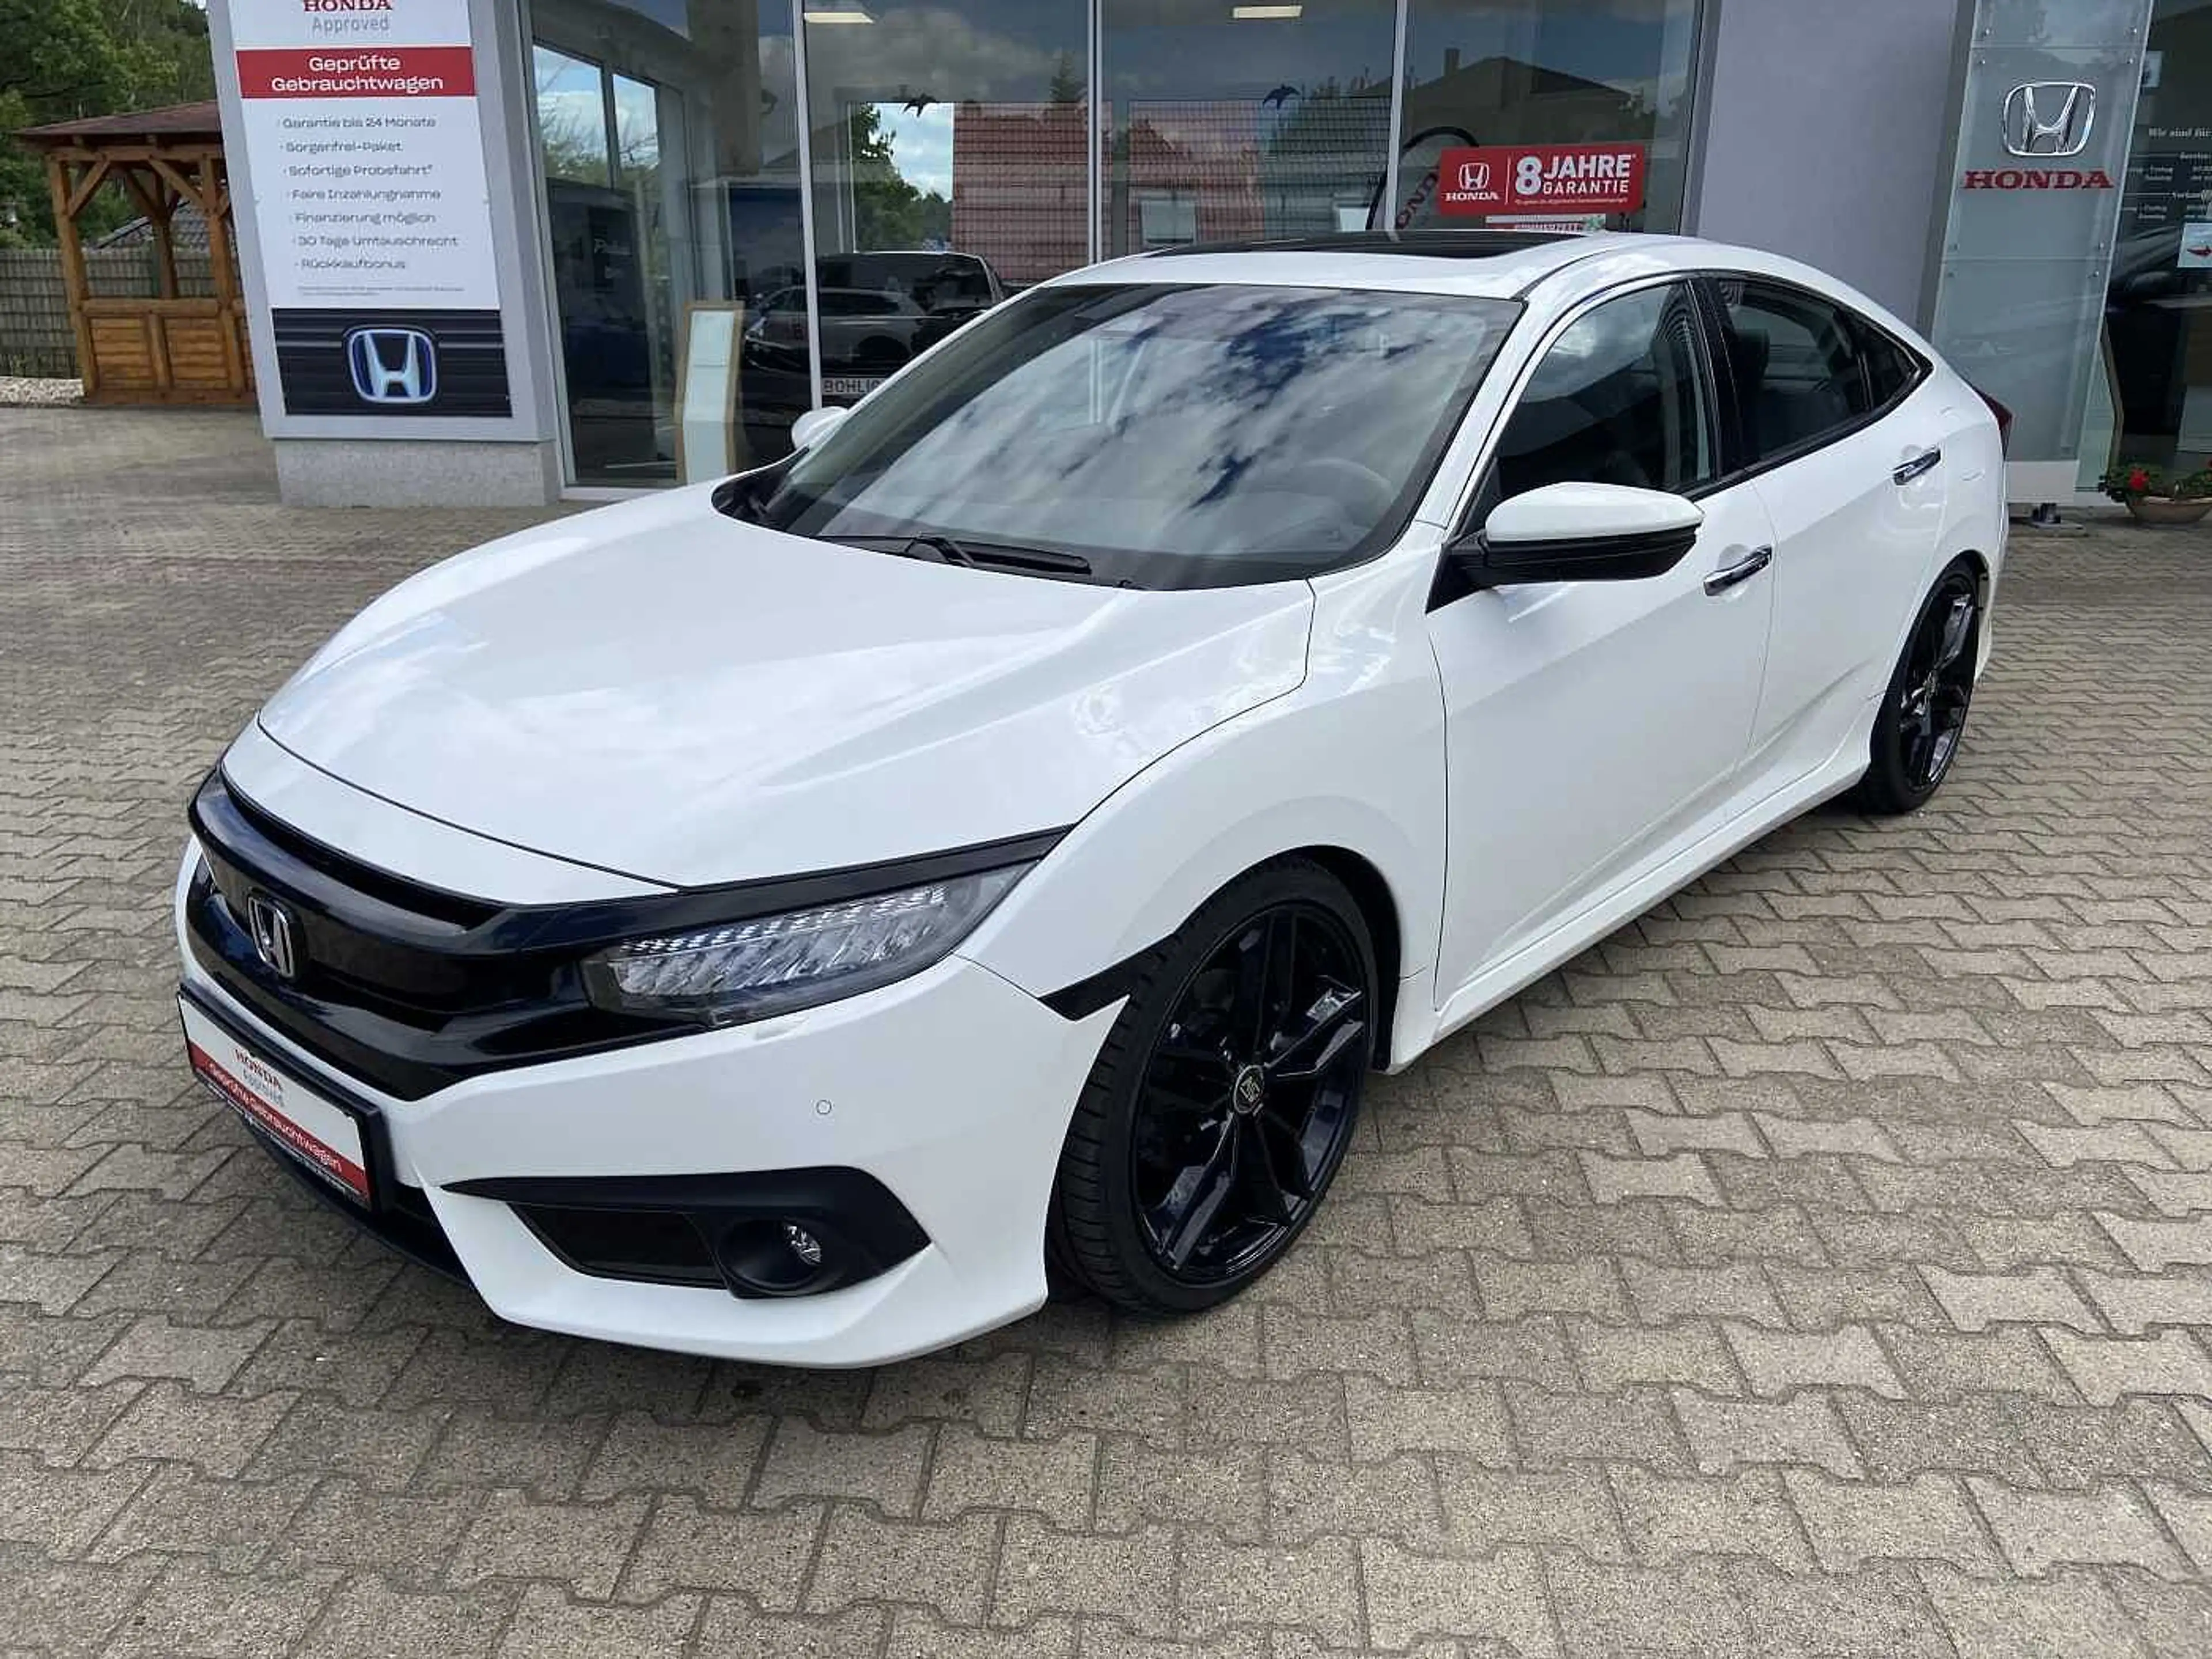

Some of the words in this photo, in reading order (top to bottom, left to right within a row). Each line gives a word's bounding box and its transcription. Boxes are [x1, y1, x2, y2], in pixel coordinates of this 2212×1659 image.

[304, 0, 393, 12] HONDA
[312, 14, 389, 33] Approved
[308, 54, 401, 74] Geprüfte
[271, 75, 444, 94] Gebrauchtwagen
[282, 117, 341, 128] Garantie
[343, 117, 363, 127] bis
[366, 117, 382, 127] 24
[385, 117, 437, 127] Monate
[289, 164, 351, 177] Sofortige
[1515, 156, 1543, 195] 8
[1963, 169, 2114, 189] HONDA
[292, 190, 325, 199] Faire
[1543, 180, 1629, 195] GARANTIE
[1441, 191, 1499, 202] HONDA
[319, 236, 350, 248] Tage
